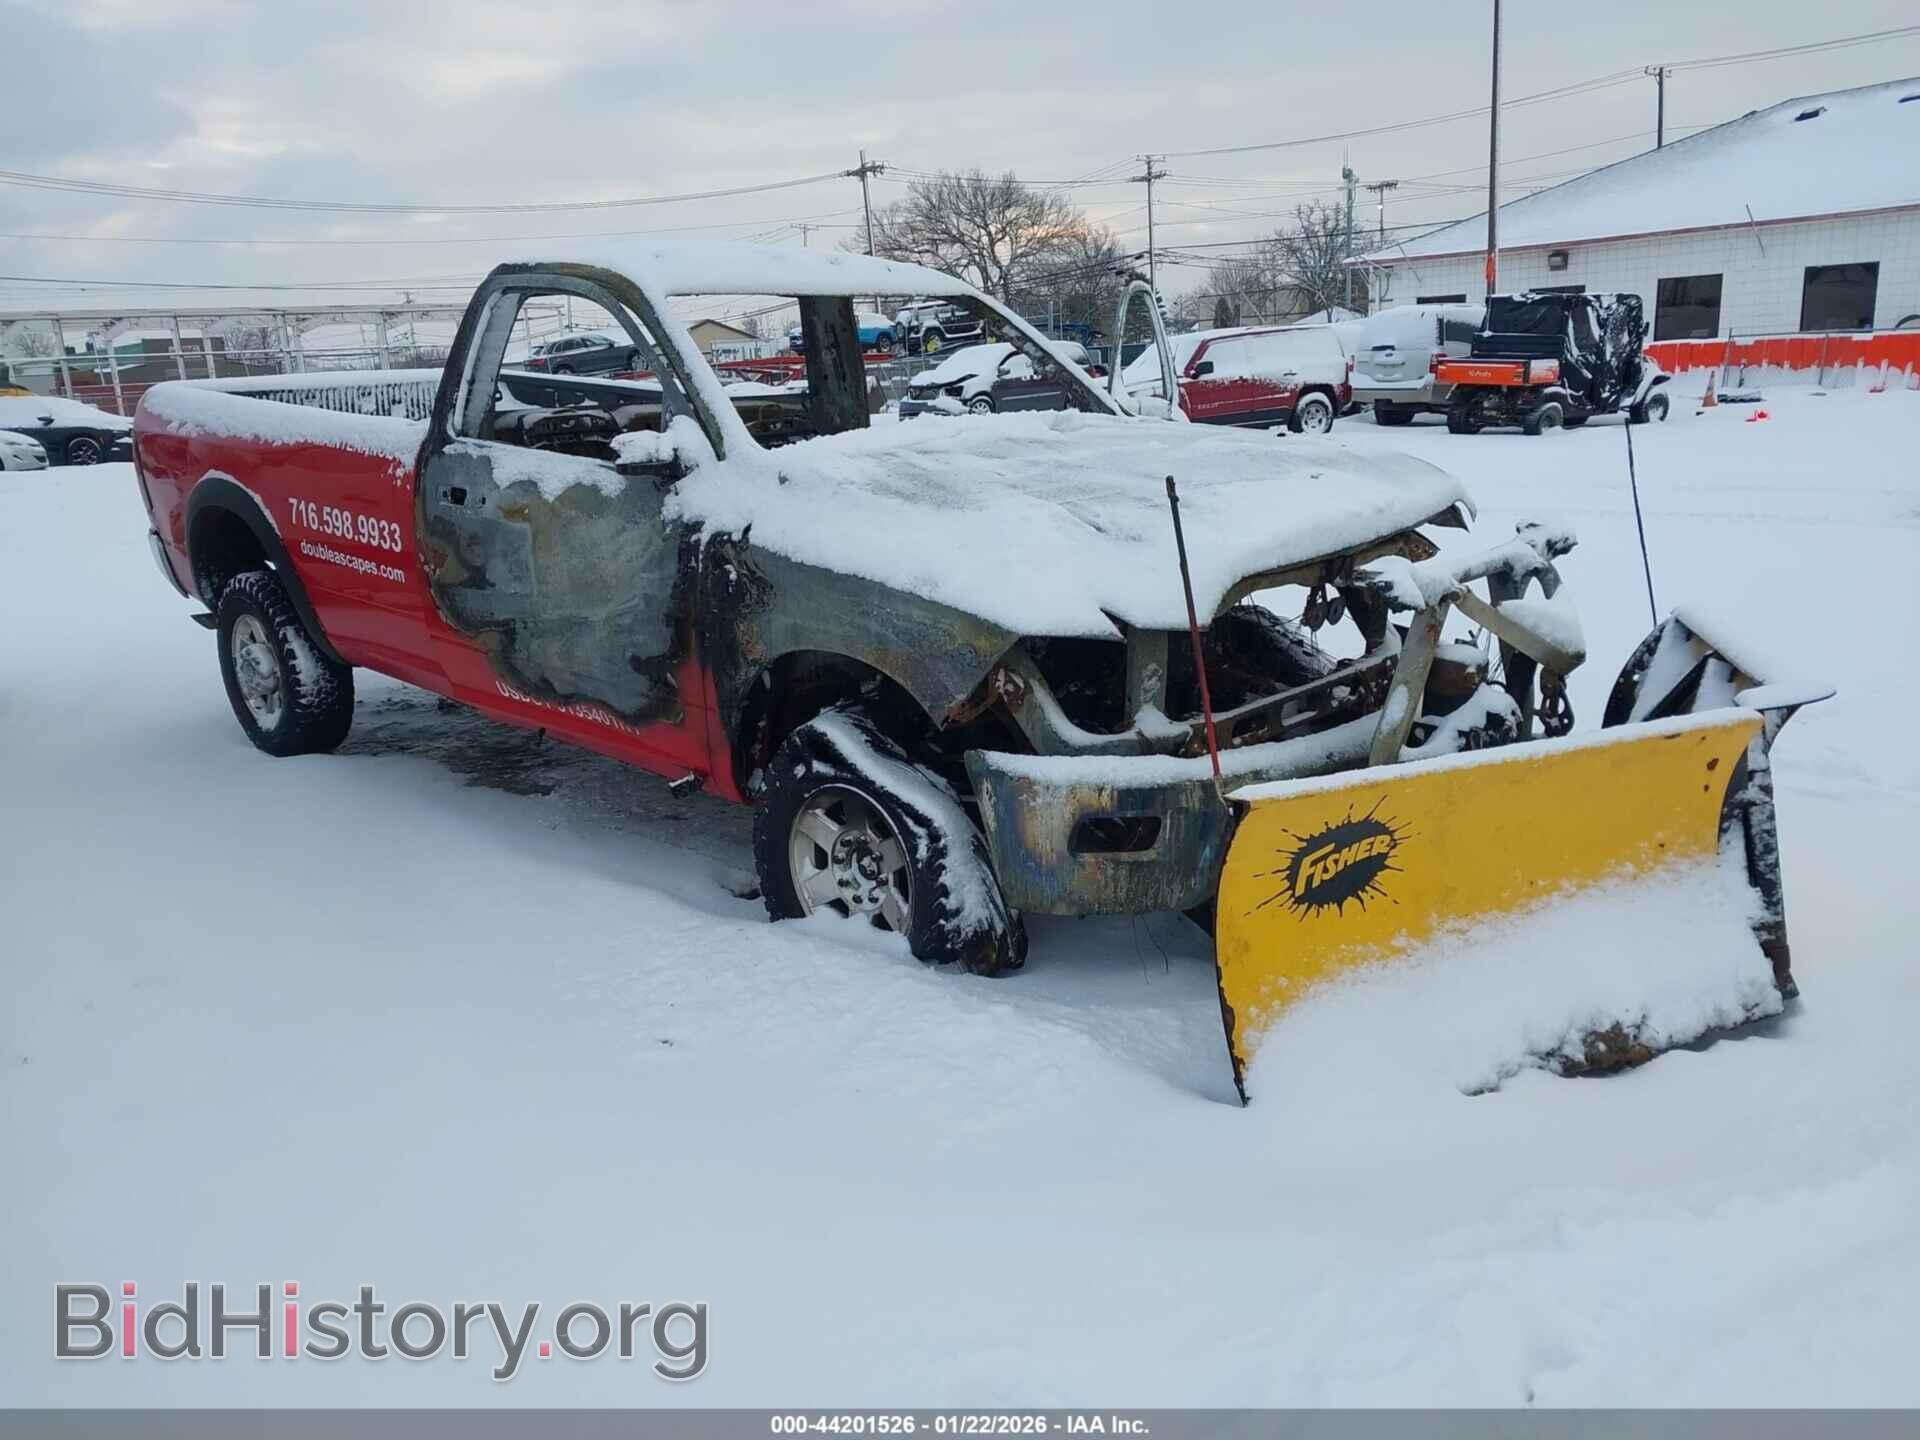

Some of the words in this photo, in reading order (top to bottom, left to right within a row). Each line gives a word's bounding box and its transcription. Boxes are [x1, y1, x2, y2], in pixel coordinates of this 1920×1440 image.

[288, 498, 402, 552] 716.598.9933
[300, 540, 405, 583] doubleascapes.com
[1295, 834, 1394, 897] FISHER
